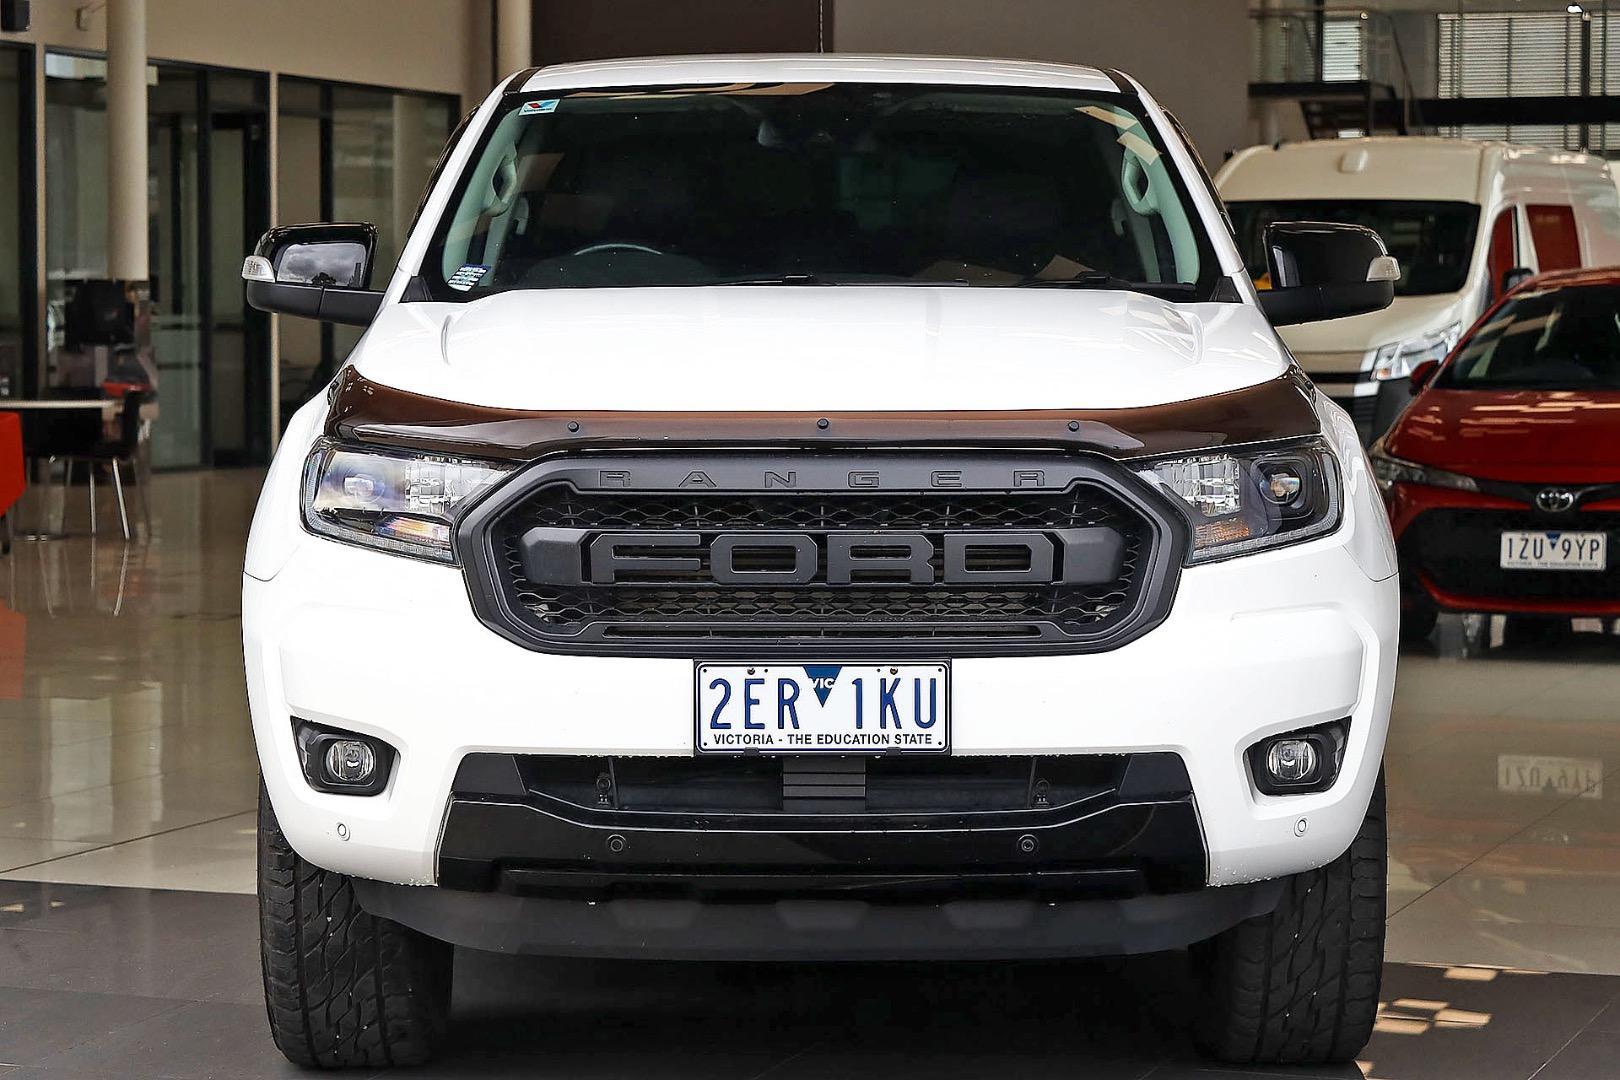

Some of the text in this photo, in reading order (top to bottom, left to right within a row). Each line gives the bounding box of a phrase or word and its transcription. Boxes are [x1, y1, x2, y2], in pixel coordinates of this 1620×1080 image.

[599, 469, 1045, 489] RANGER
[590, 533, 1055, 585] FORD
[1508, 537, 1600, 560] 1ZU 9YP
[811, 677, 836, 689] VIC
[709, 678, 937, 729] 2ER 1KU
[713, 733, 774, 745] VICTORIA
[787, 733, 812, 745] THE
[817, 733, 890, 745] EDUCATION
[894, 733, 933, 745] STATE
